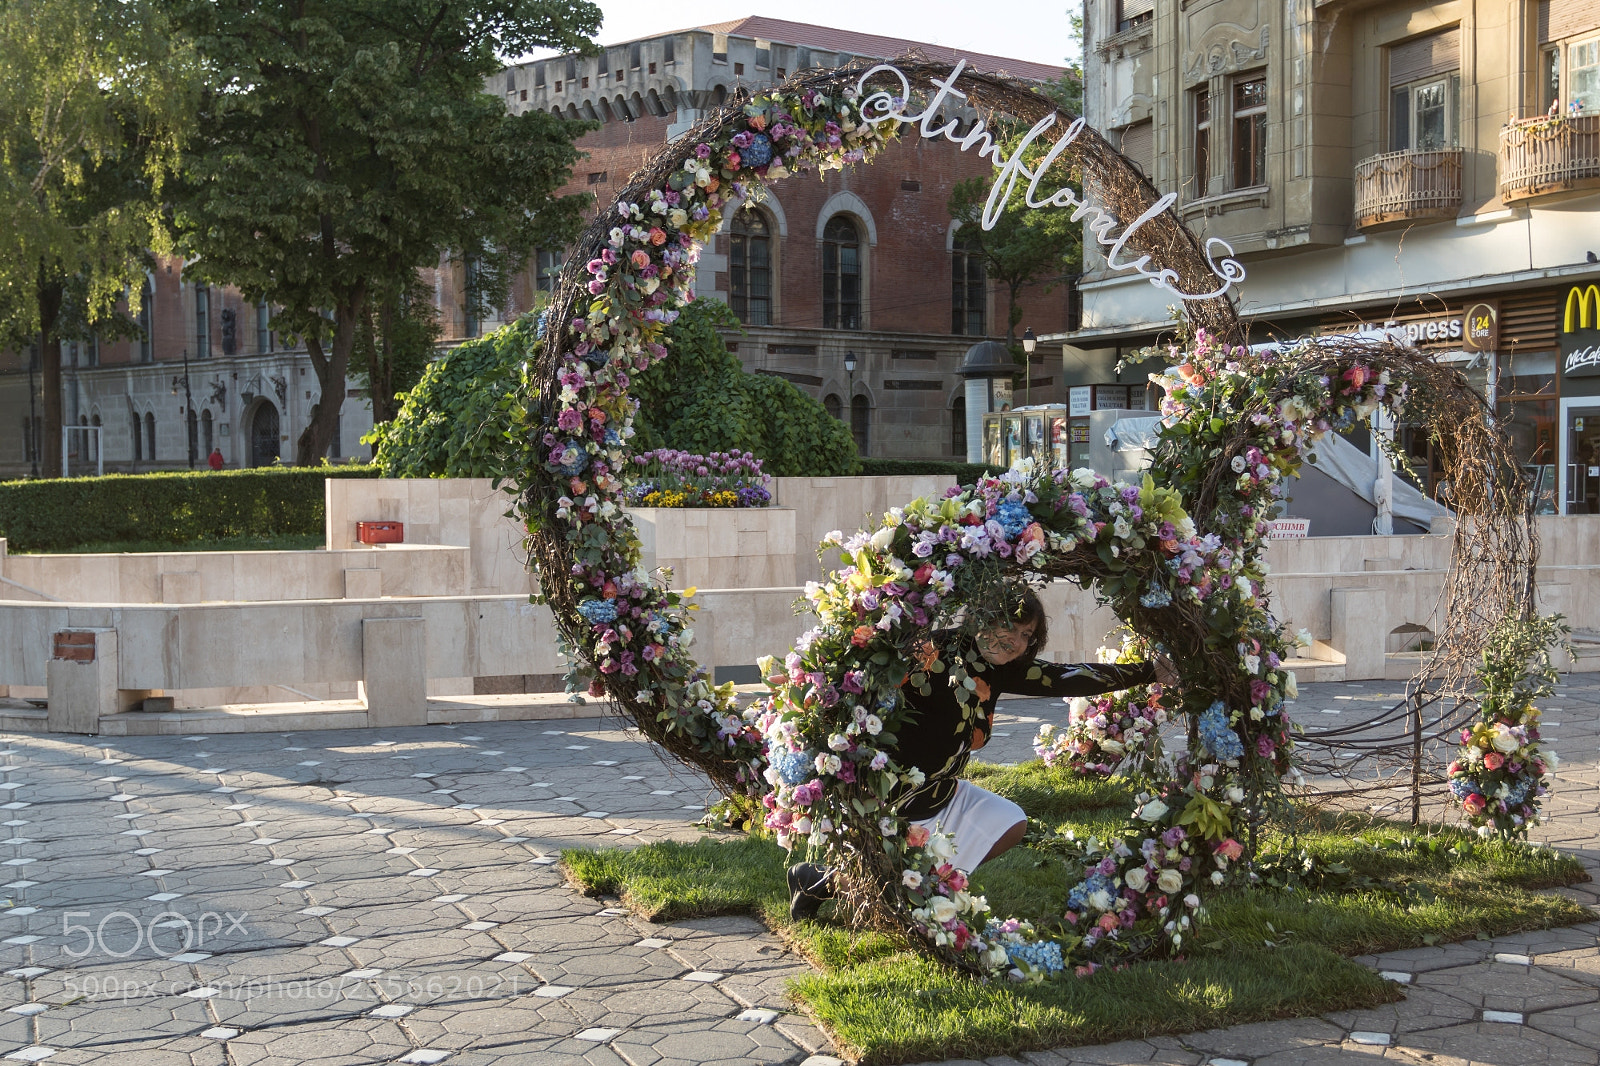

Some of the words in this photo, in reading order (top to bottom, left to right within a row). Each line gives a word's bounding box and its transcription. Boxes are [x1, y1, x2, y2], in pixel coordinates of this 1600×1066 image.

[1476, 315, 1489, 330] 24
[1384, 319, 1461, 347] press
[1475, 329, 1489, 337] ORE
[1565, 345, 1600, 370] McCaf
[1273, 522, 1305, 531] CHIMB
